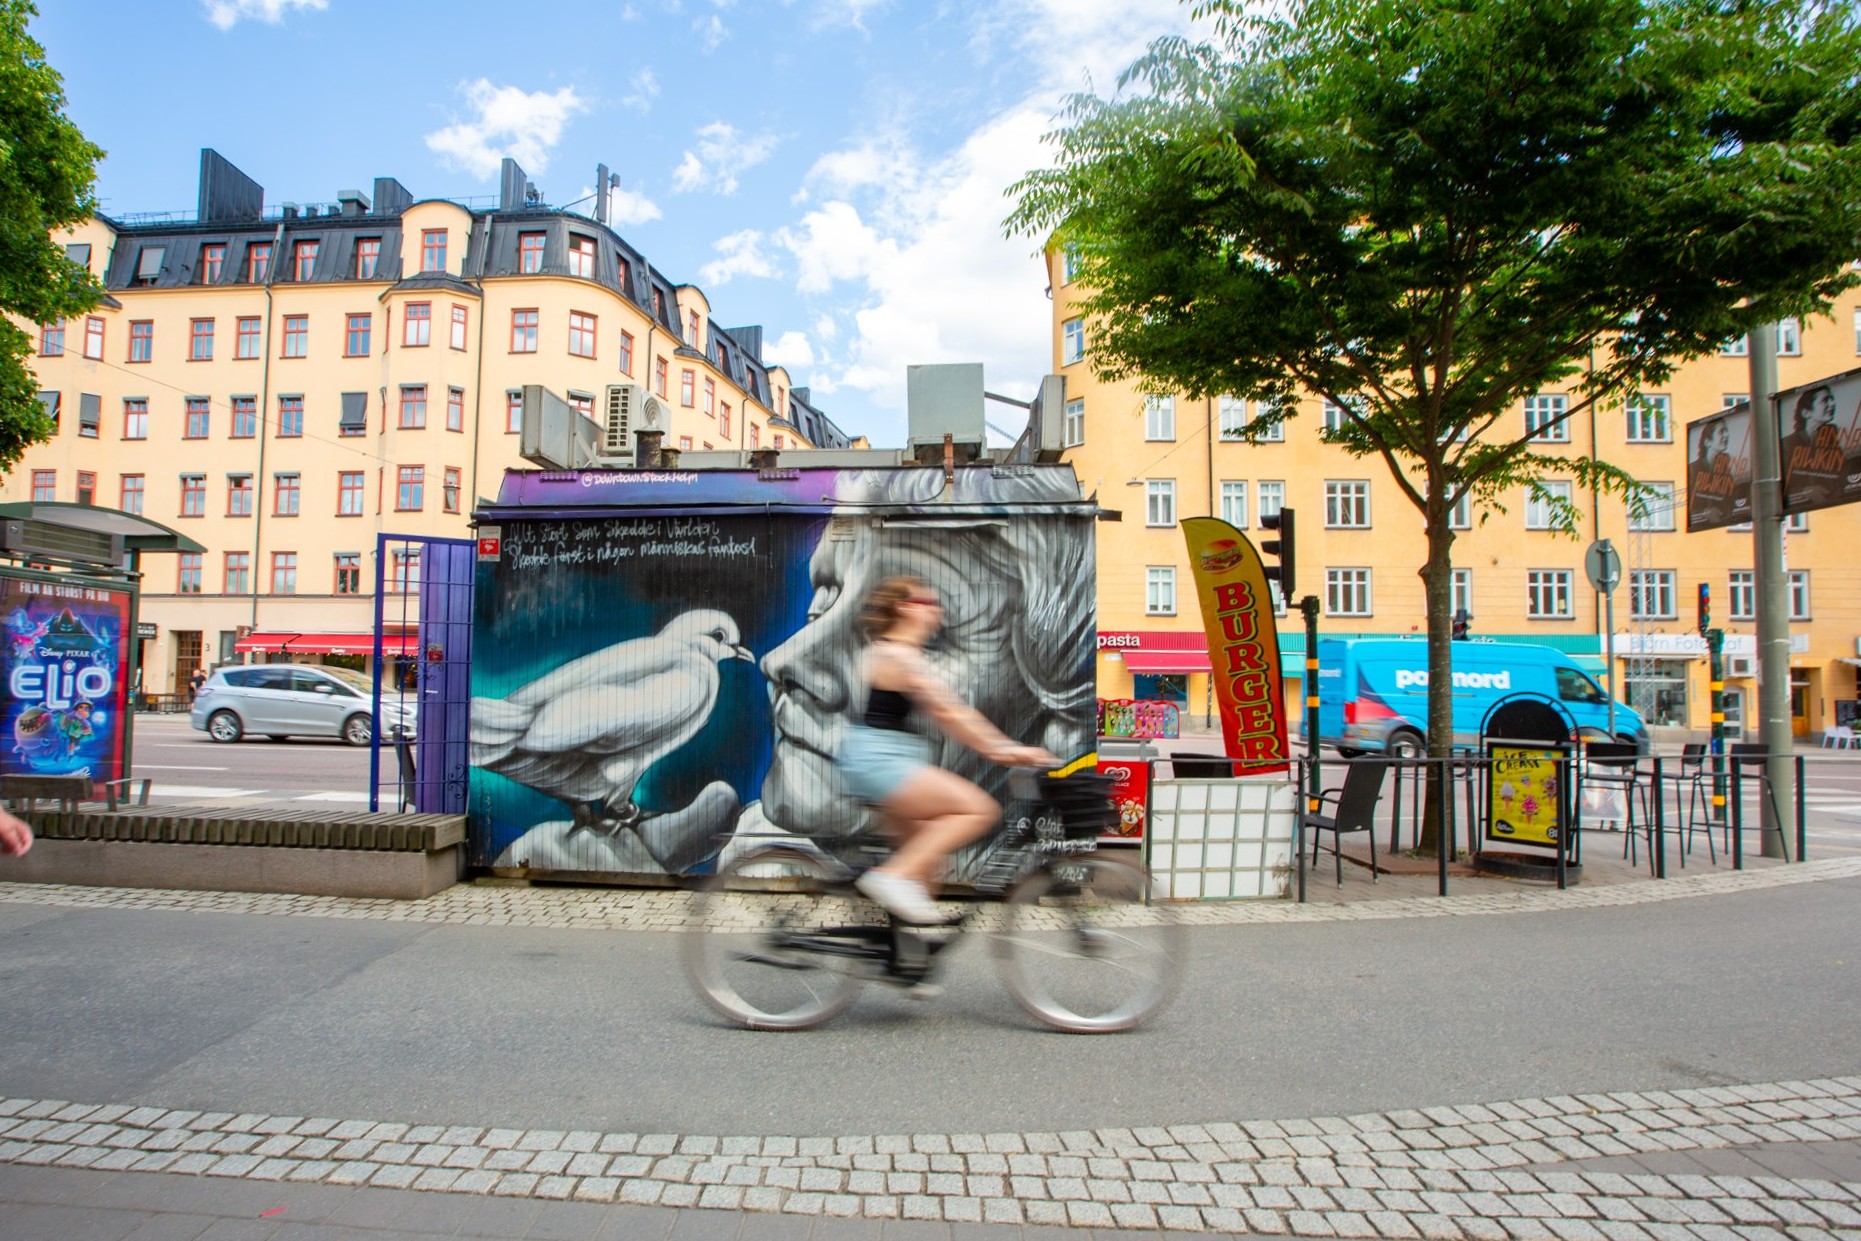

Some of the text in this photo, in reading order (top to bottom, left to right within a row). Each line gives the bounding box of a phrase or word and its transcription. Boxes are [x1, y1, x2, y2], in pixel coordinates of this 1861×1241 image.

[597, 541, 634, 566] någon
[20, 581, 40, 594] FILM
[1097, 634, 1141, 648] pasta
[1675, 635, 1743, 650] Fotoaf
[40, 647, 63, 659] Disney
[1214, 581, 1284, 768] BURGER
[1396, 670, 1511, 690] ponord
